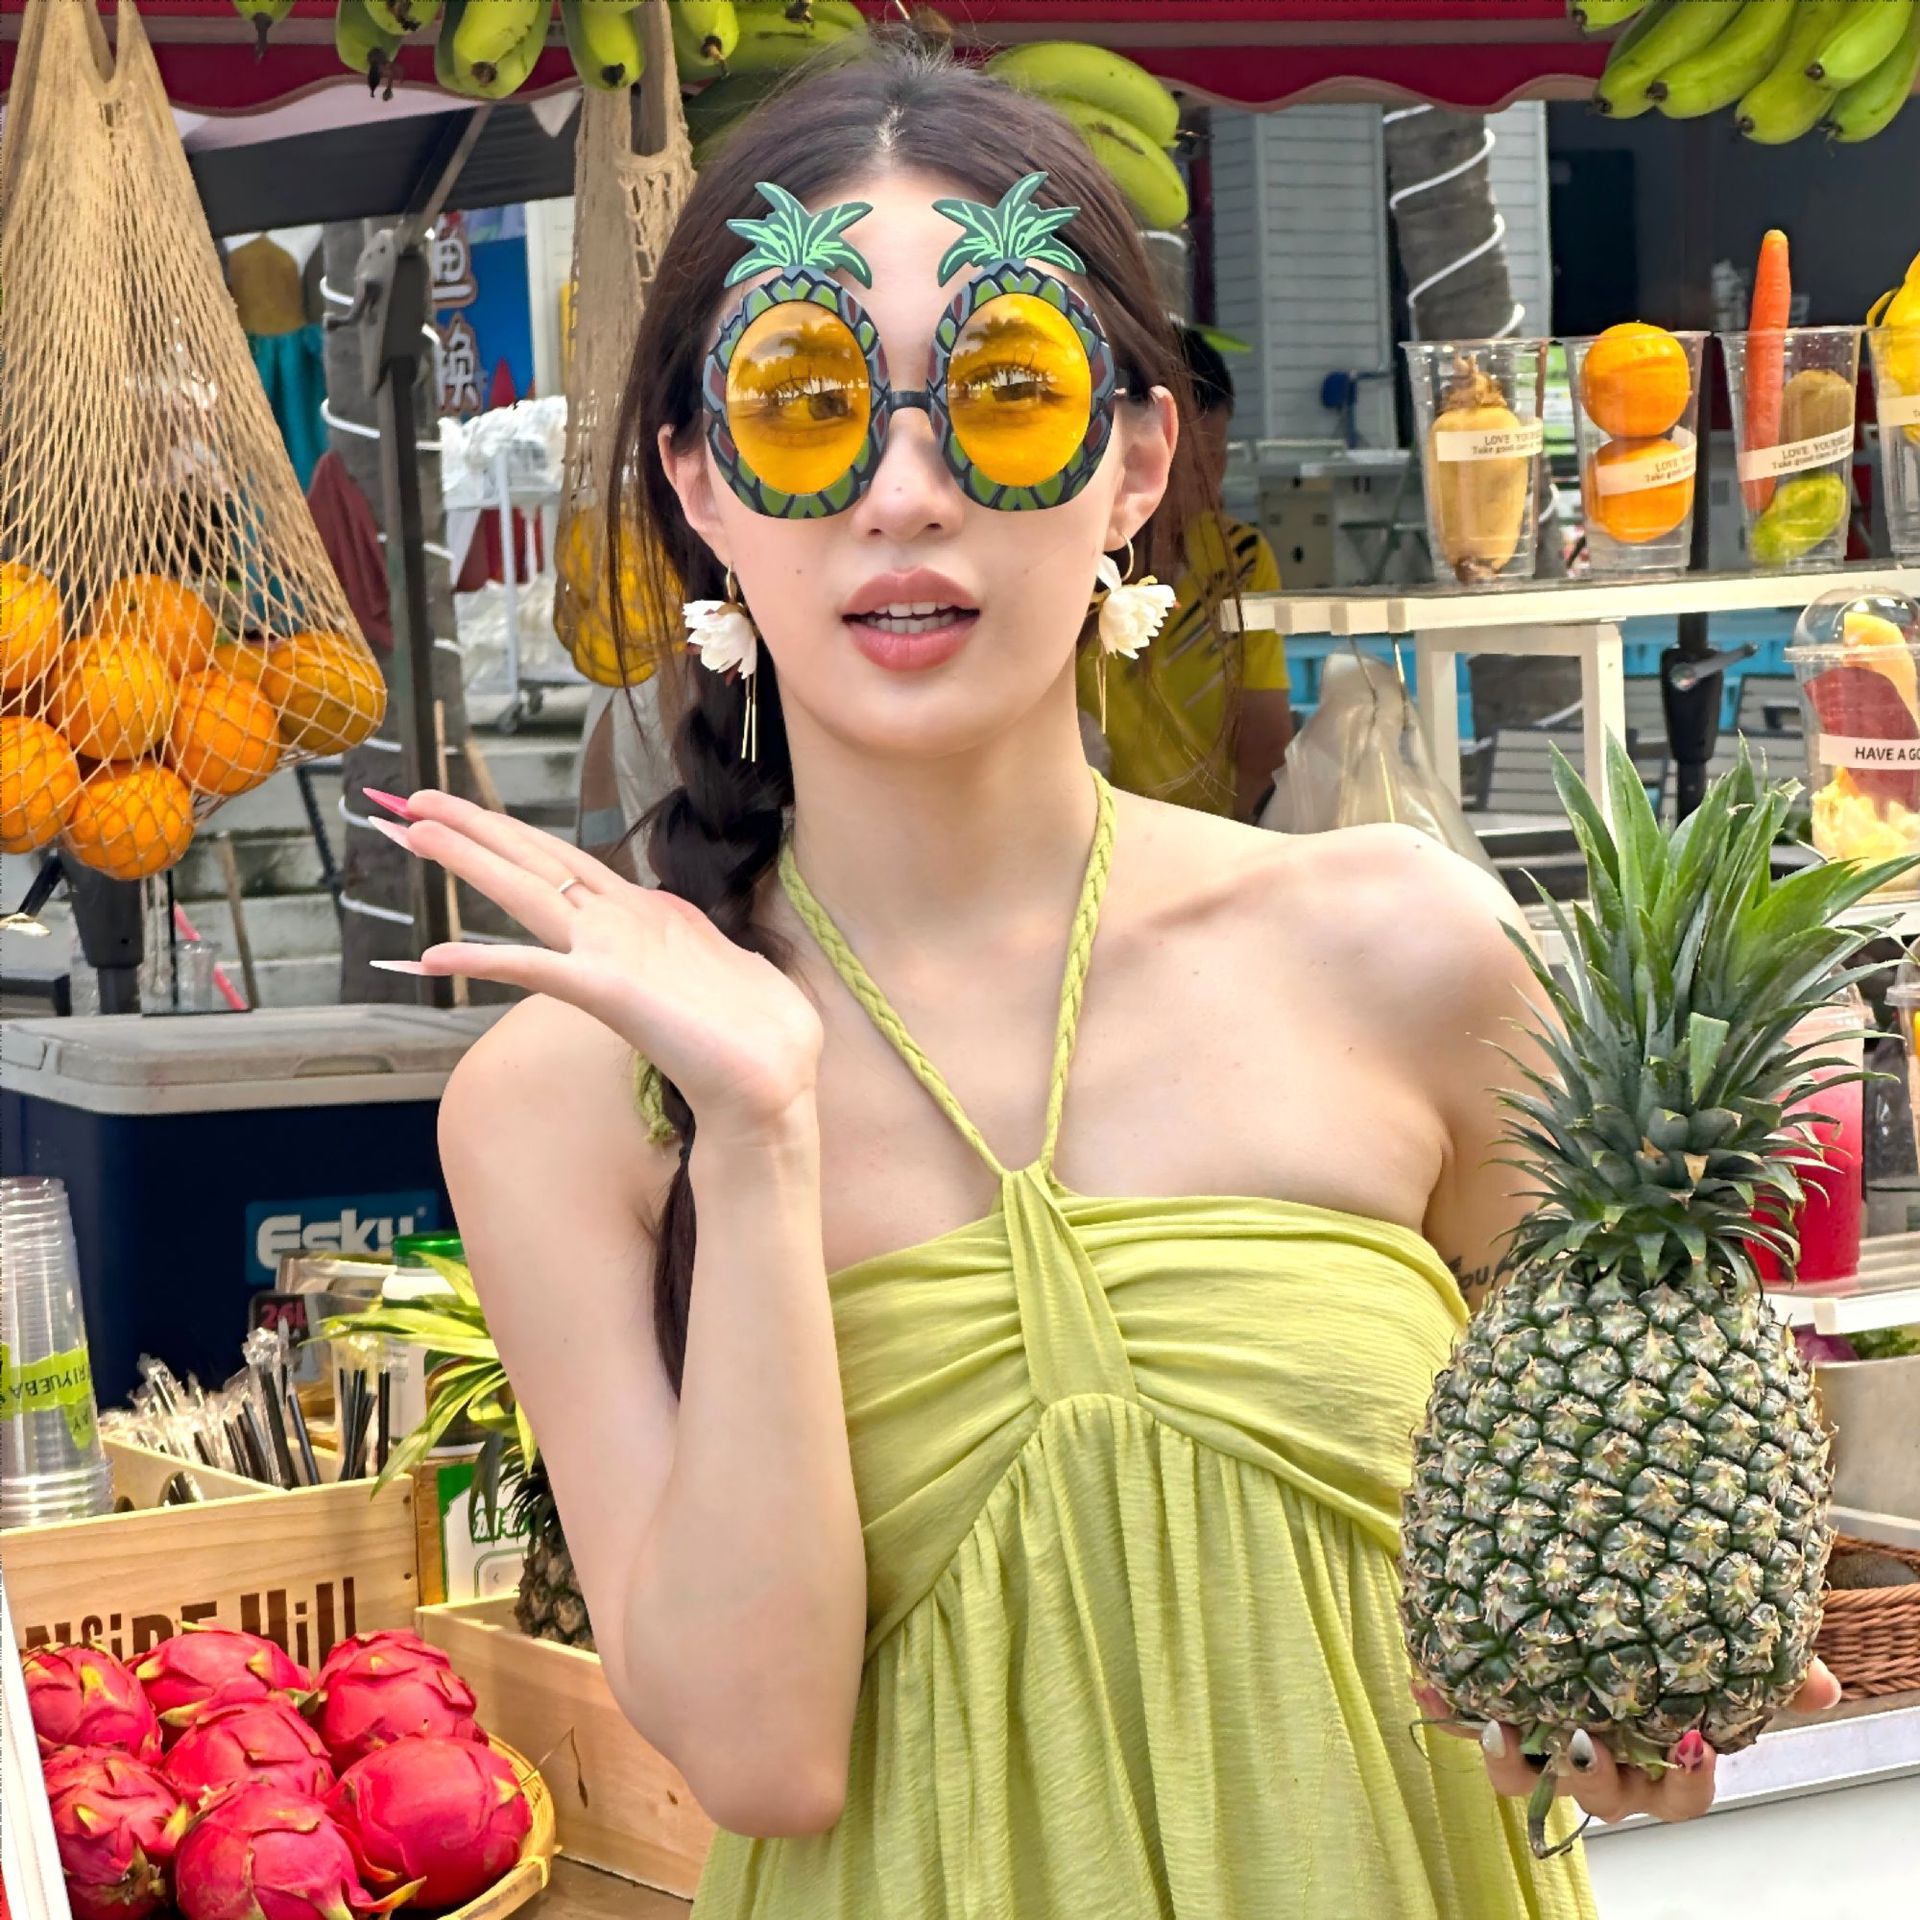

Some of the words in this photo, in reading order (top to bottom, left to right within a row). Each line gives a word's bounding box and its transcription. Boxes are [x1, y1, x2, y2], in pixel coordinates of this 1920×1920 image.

[1484, 434, 1510, 446] LOVE
[1782, 446, 1808, 460] LOVE
[1855, 746, 1894, 761] HAVE
[1897, 747, 1906, 761] A
[0, 1364, 86, 1404] RIYUEBA
[240, 1577, 356, 1672] Hill
